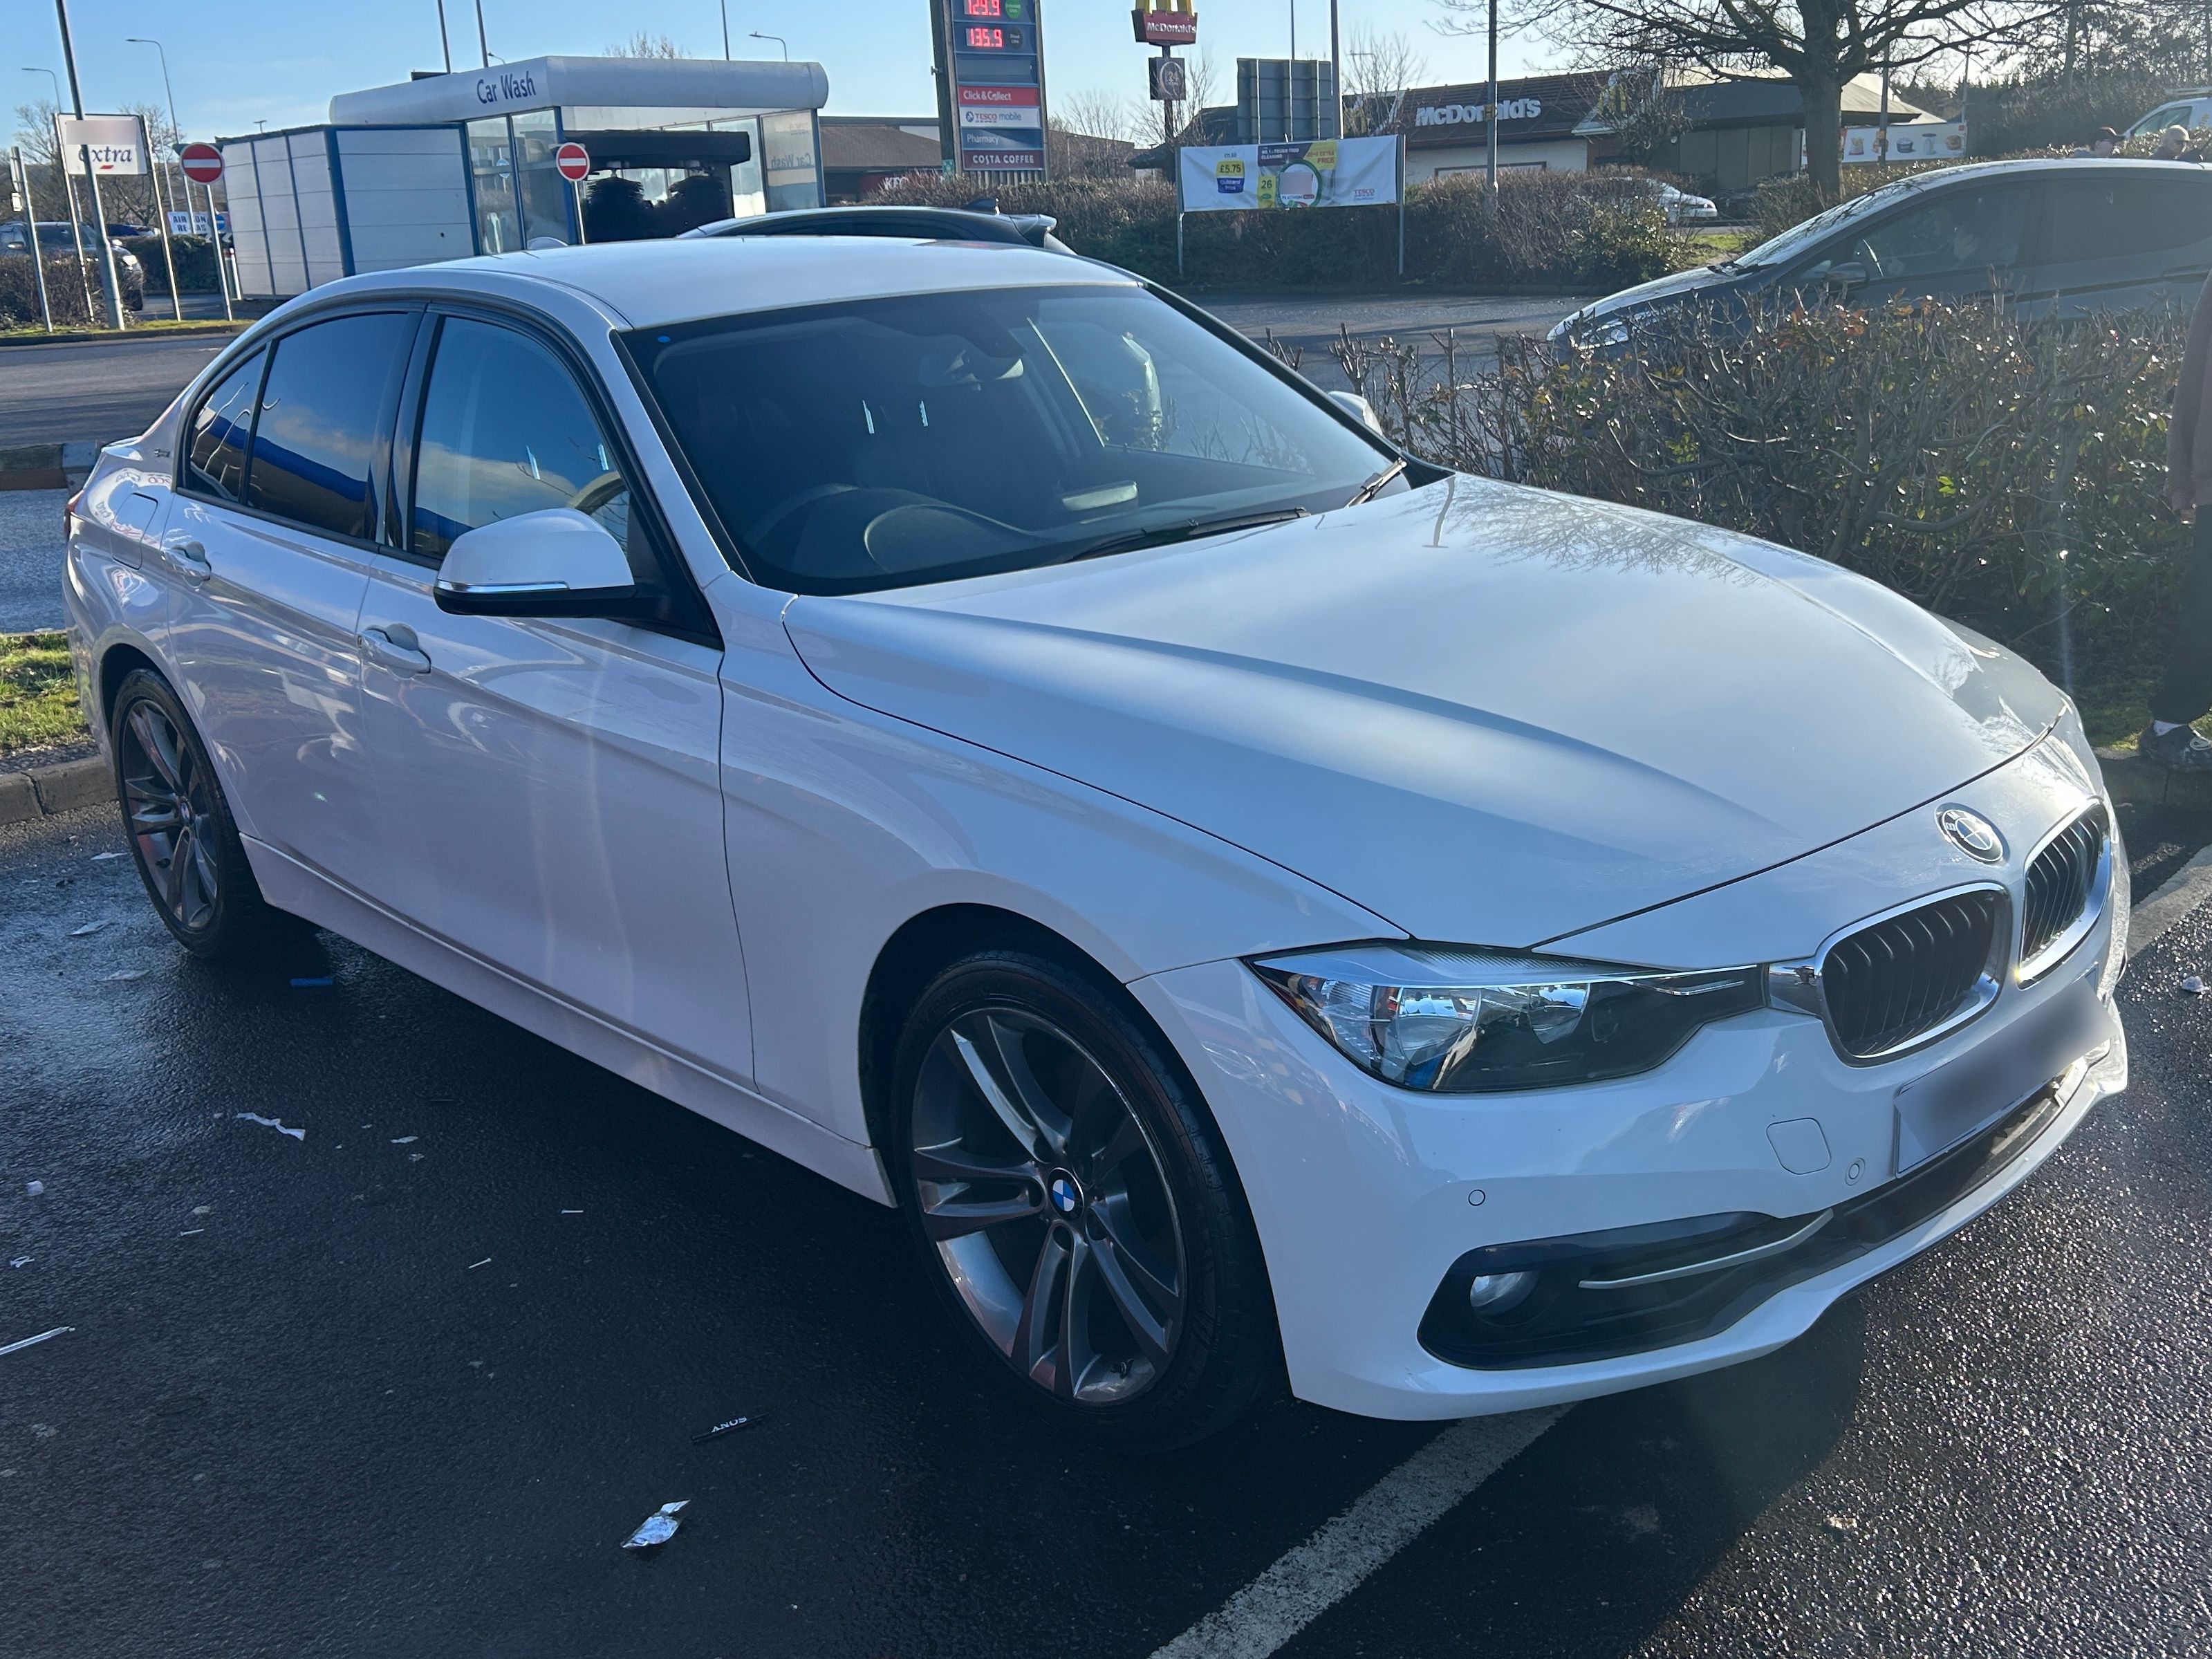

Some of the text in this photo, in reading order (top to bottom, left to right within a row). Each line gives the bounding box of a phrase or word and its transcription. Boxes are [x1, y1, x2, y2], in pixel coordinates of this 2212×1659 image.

[968, 0, 1001, 16] 129.9
[970, 28, 1003, 48] 135.9
[476, 70, 536, 104] Car Wash
[975, 111, 1022, 122] TESCO mobile
[967, 133, 998, 145] Pharmacy
[972, 154, 1034, 165] COSTA COFFEE
[1219, 164, 1241, 173] £5.75
[1261, 180, 1272, 189] 26
[711, 1416, 747, 1433] SONY
